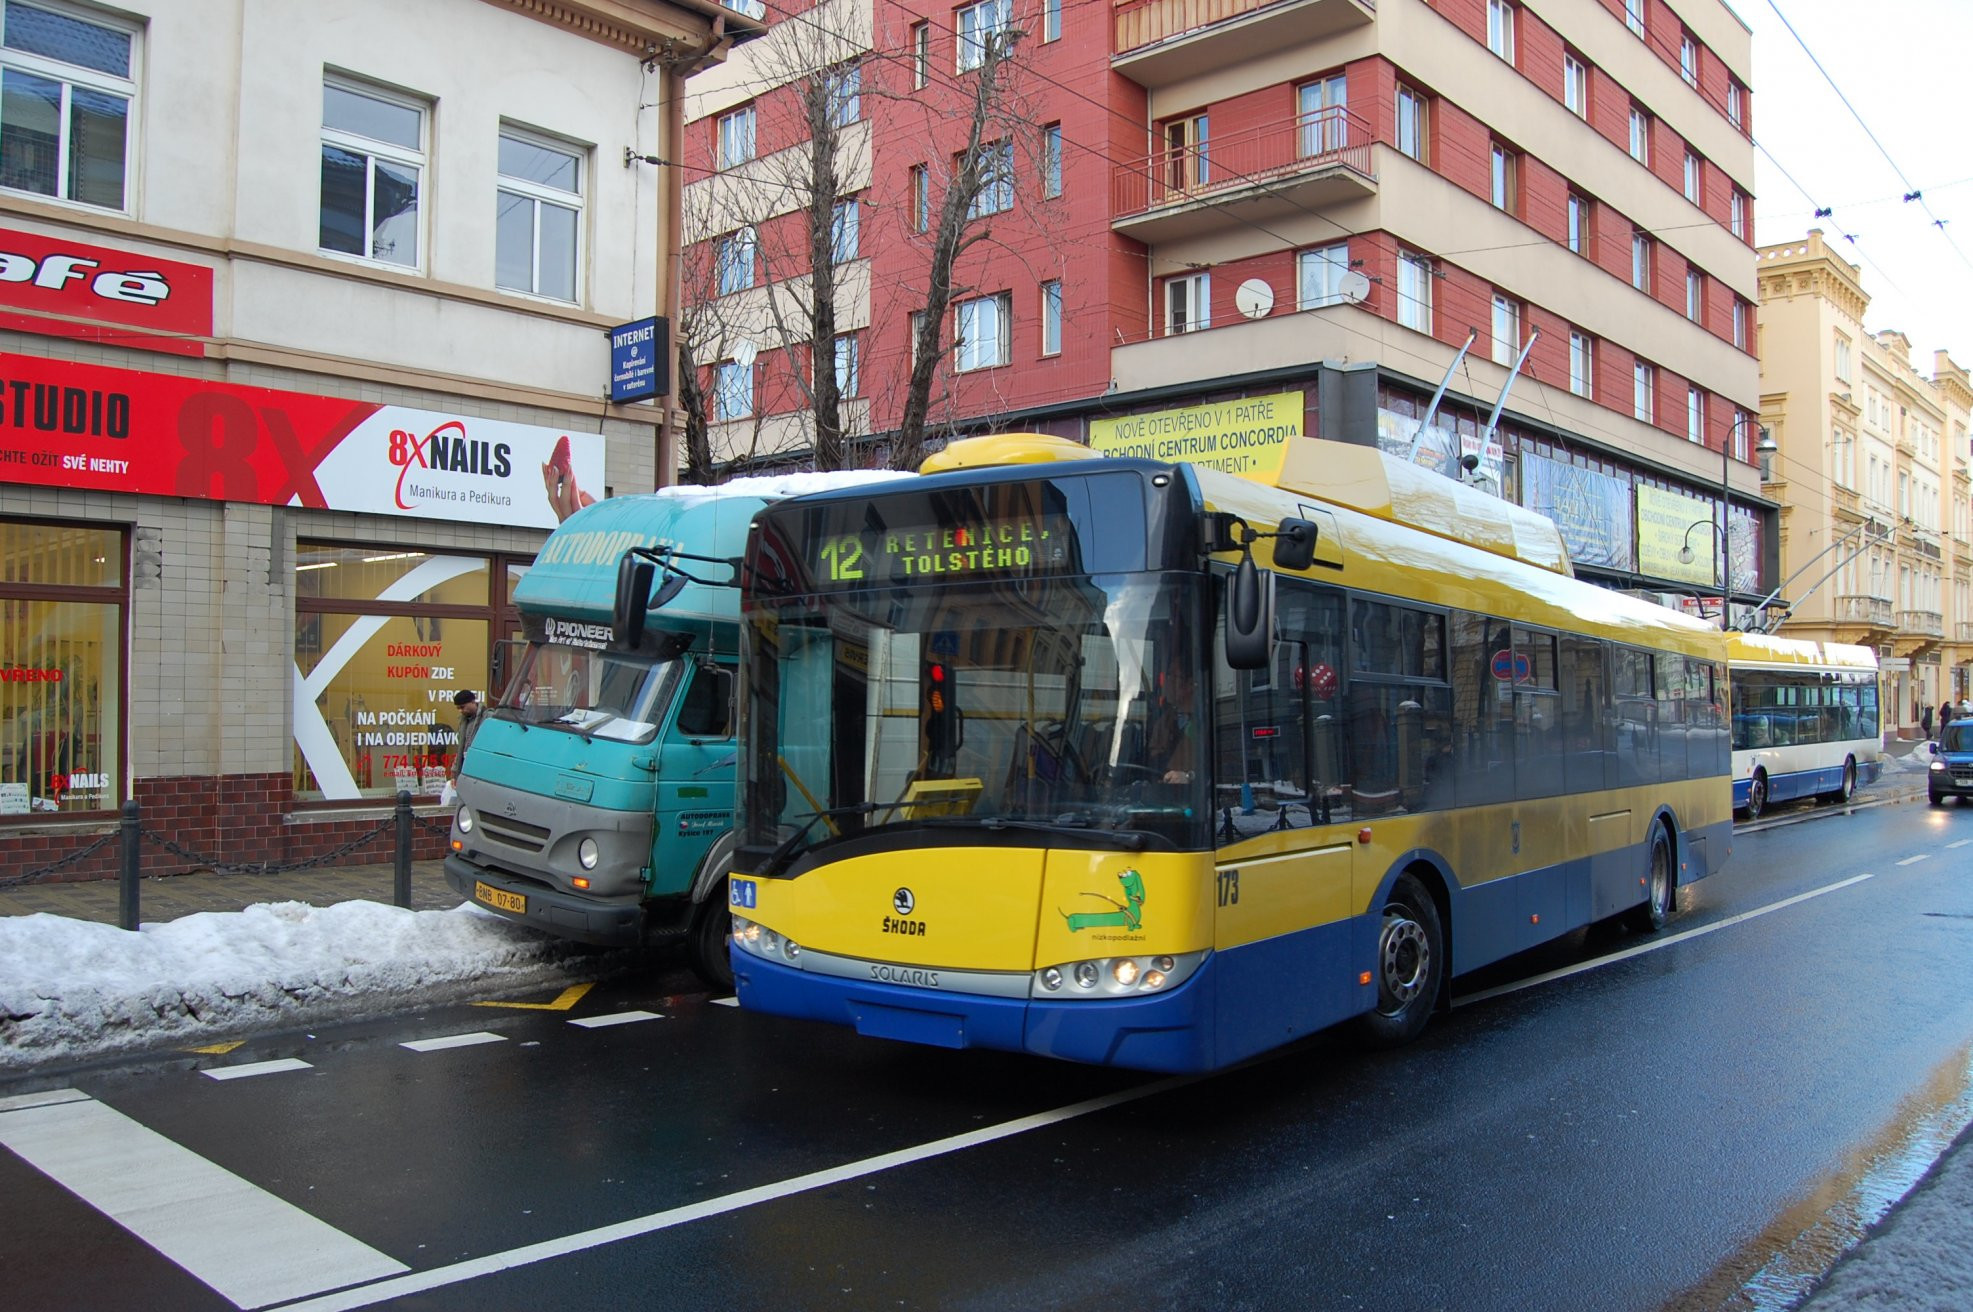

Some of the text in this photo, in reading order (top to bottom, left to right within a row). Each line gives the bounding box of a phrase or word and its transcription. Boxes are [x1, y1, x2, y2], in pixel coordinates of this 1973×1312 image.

[613, 325, 655, 349] INTERNET
[0, 379, 130, 439] TUDIO
[1115, 400, 1274, 439] NOVĚ OTEVŘENO V 1 PATŘE
[1096, 424, 1297, 459] BCHODNÍ CENTRUM CONCORDIA
[31, 449, 60, 467] OŽÍT
[62, 454, 86, 471] SVÉ
[90, 457, 129, 474] NEHTY
[409, 484, 512, 506] Manikura a Pedikura
[540, 530, 684, 567] AUTODOPA
[821, 536, 863, 581] 12
[901, 546, 1031, 574] TOLSTÉHO
[556, 621, 615, 642] PIONEER
[387, 642, 442, 657] DÁRKOVÝ
[387, 664, 455, 680] KUPÓN ZDE
[428, 690, 485, 703] V PRJI
[357, 709, 436, 725] NA POČKÁNÍ
[357, 733, 362, 746] I
[365, 732, 384, 746] NA
[383, 754, 409, 769] 774
[479, 886, 492, 902] BNB
[1217, 868, 1239, 907] 173
[882, 915, 926, 937] ŠKODA
[870, 965, 939, 987] SOLARIS
